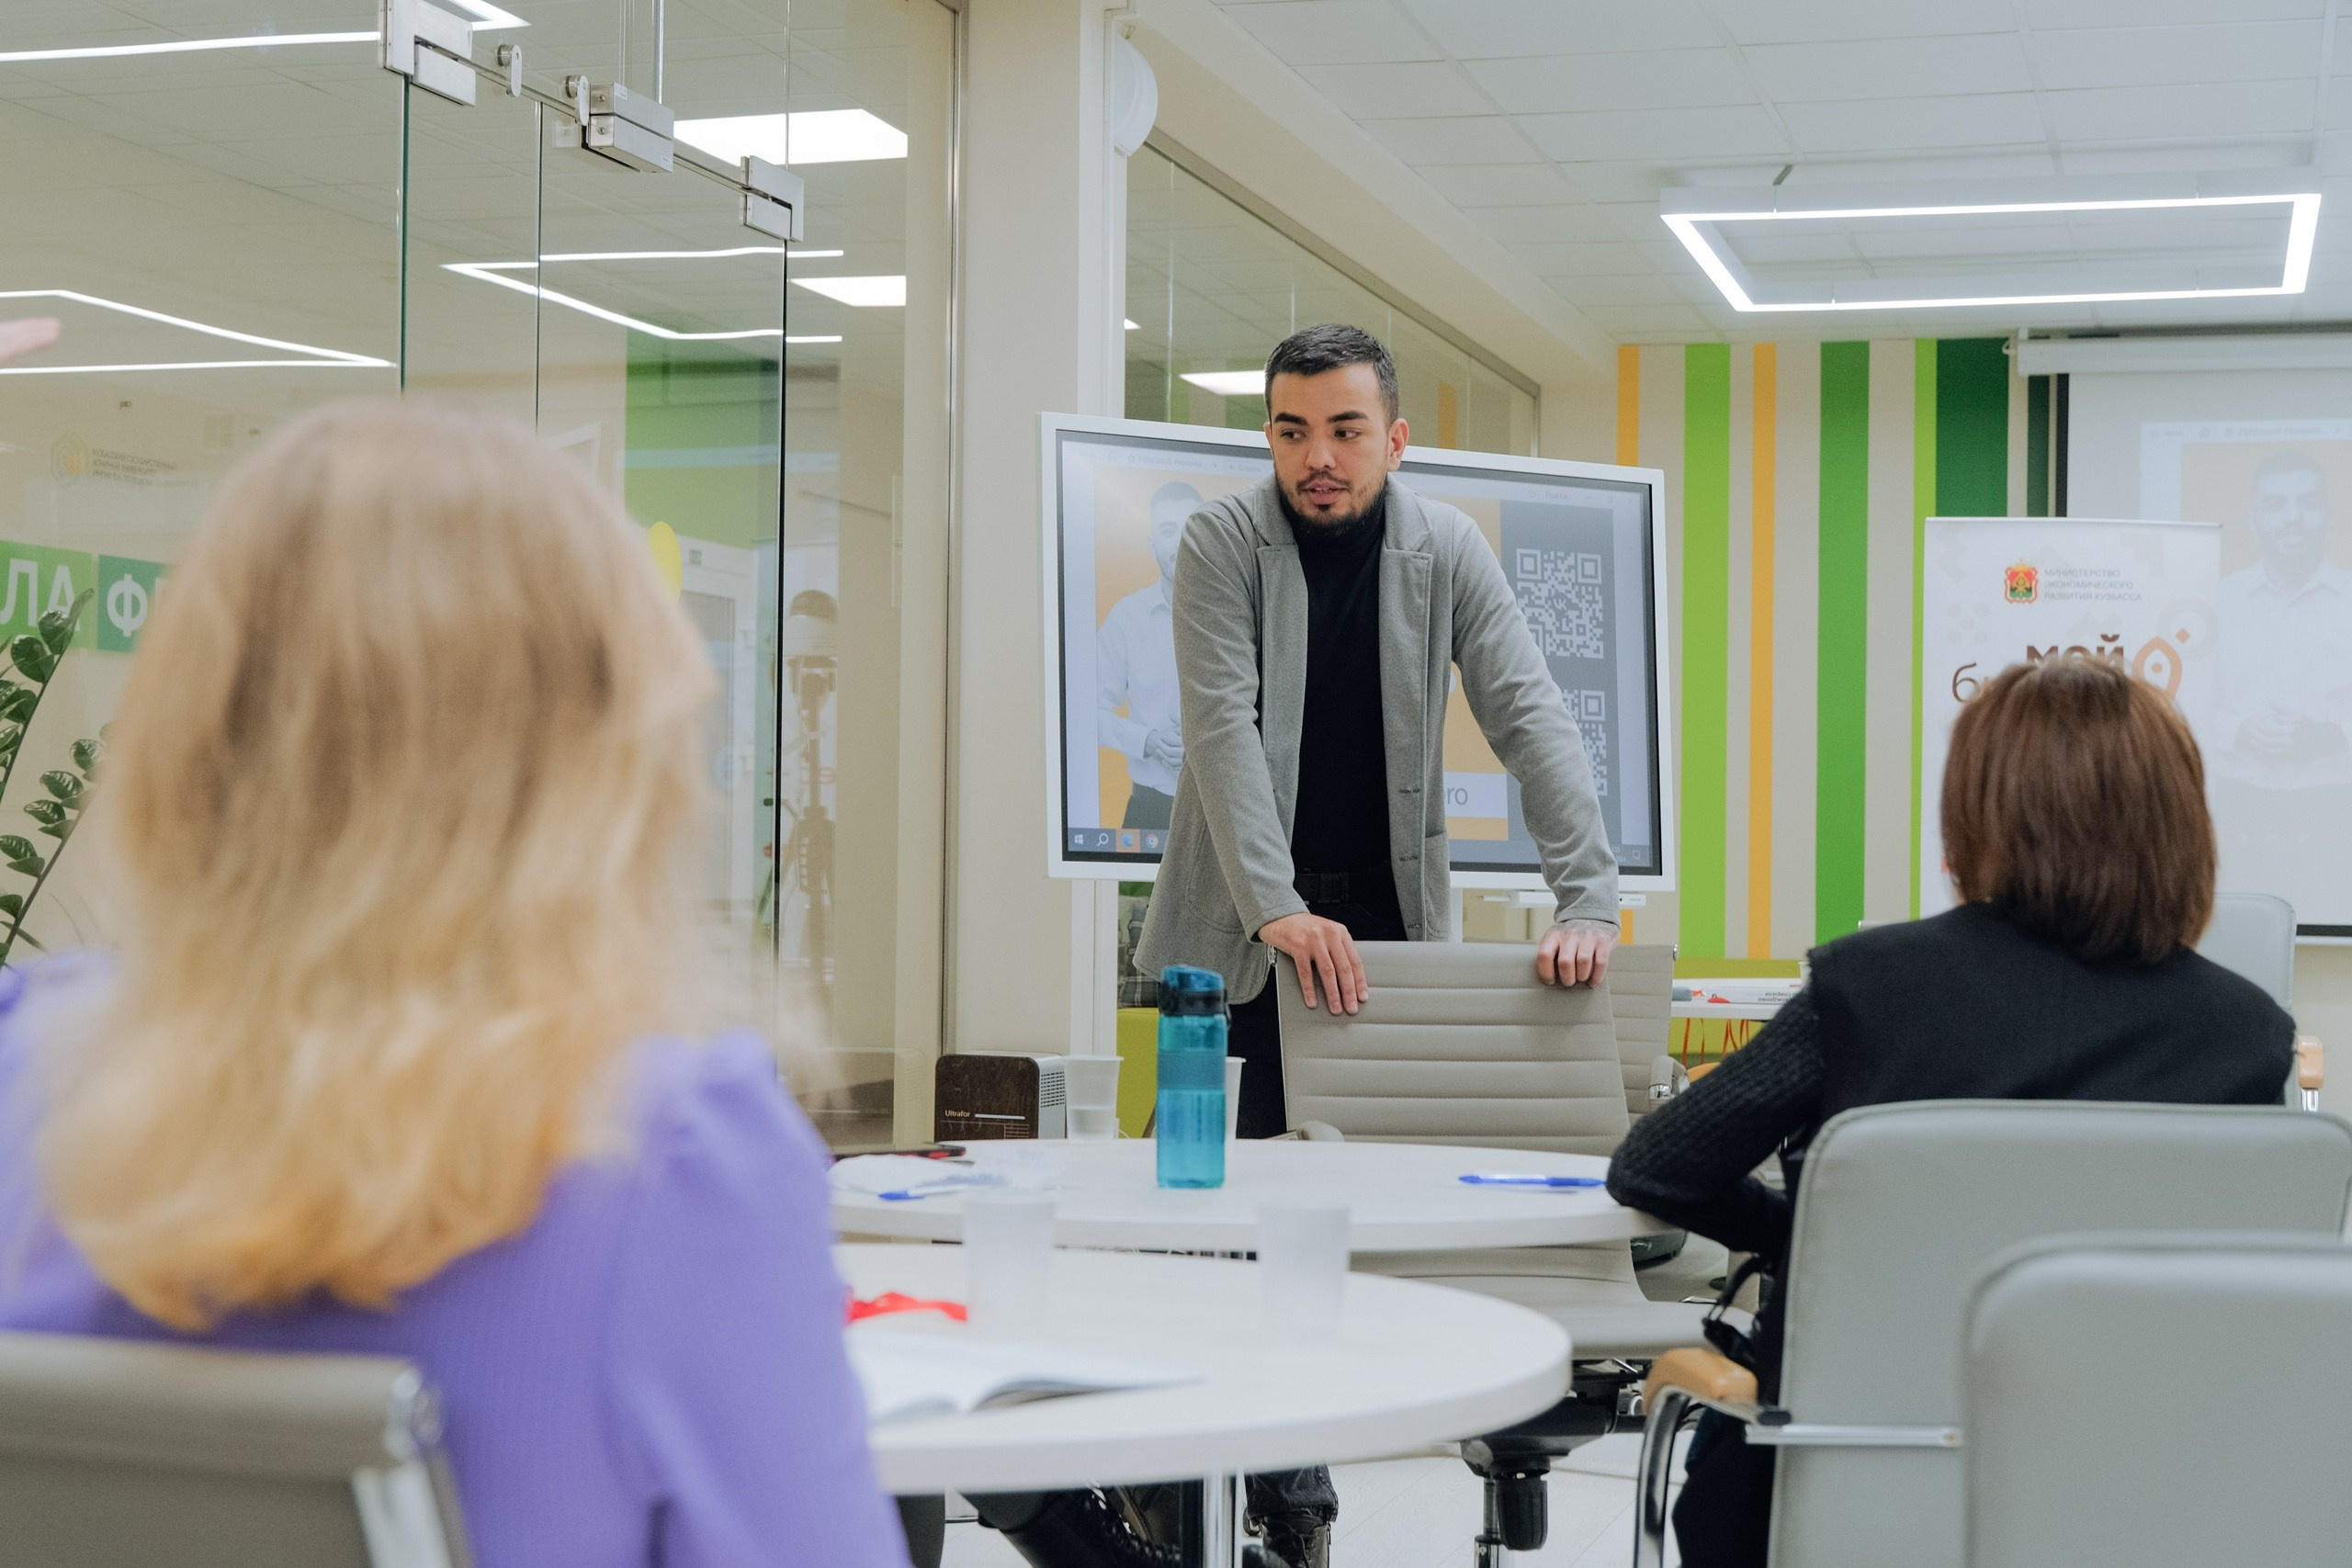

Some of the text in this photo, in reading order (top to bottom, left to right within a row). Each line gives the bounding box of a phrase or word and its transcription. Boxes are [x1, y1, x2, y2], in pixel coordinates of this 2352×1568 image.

[2044, 569, 2120, 578] МИНИСТЕРСТВО
[2044, 581, 2133, 590] ЭКОНОМИЧЕСКОГО
[2044, 592, 2143, 602] РАЗВИТИЯ КУЗБАССА
[1446, 787, 1469, 806] ro
